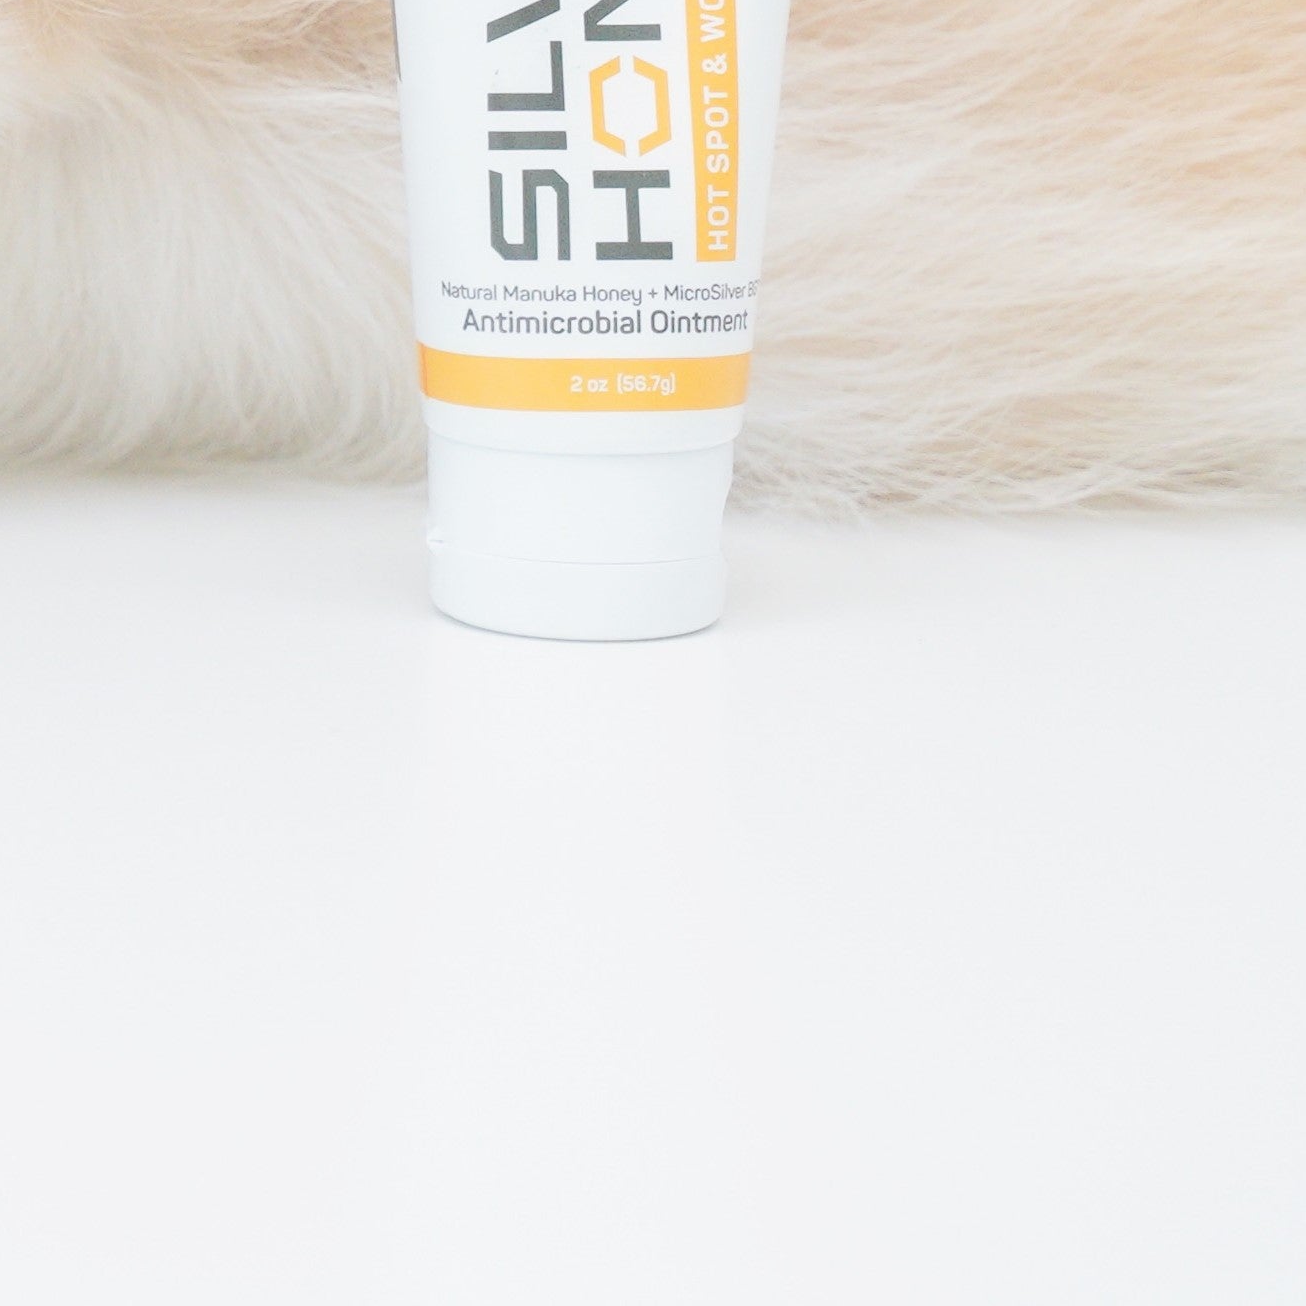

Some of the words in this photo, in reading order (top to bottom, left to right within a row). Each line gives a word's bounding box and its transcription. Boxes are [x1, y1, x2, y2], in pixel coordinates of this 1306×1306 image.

[702, 54, 728, 74] &
[703, 85, 730, 173] SPOT
[707, 184, 729, 251] HOT
[441, 280, 497, 301] Natural
[503, 285, 577, 302] Manuka
[583, 285, 642, 306] Honey
[648, 289, 658, 299] +
[664, 284, 746, 301] MicroSilver
[462, 308, 641, 334] Antimicrobial
[650, 309, 748, 333] Ointment
[570, 375, 583, 393] 2
[587, 379, 608, 393] oz
[616, 373, 676, 395] (56.7g)
